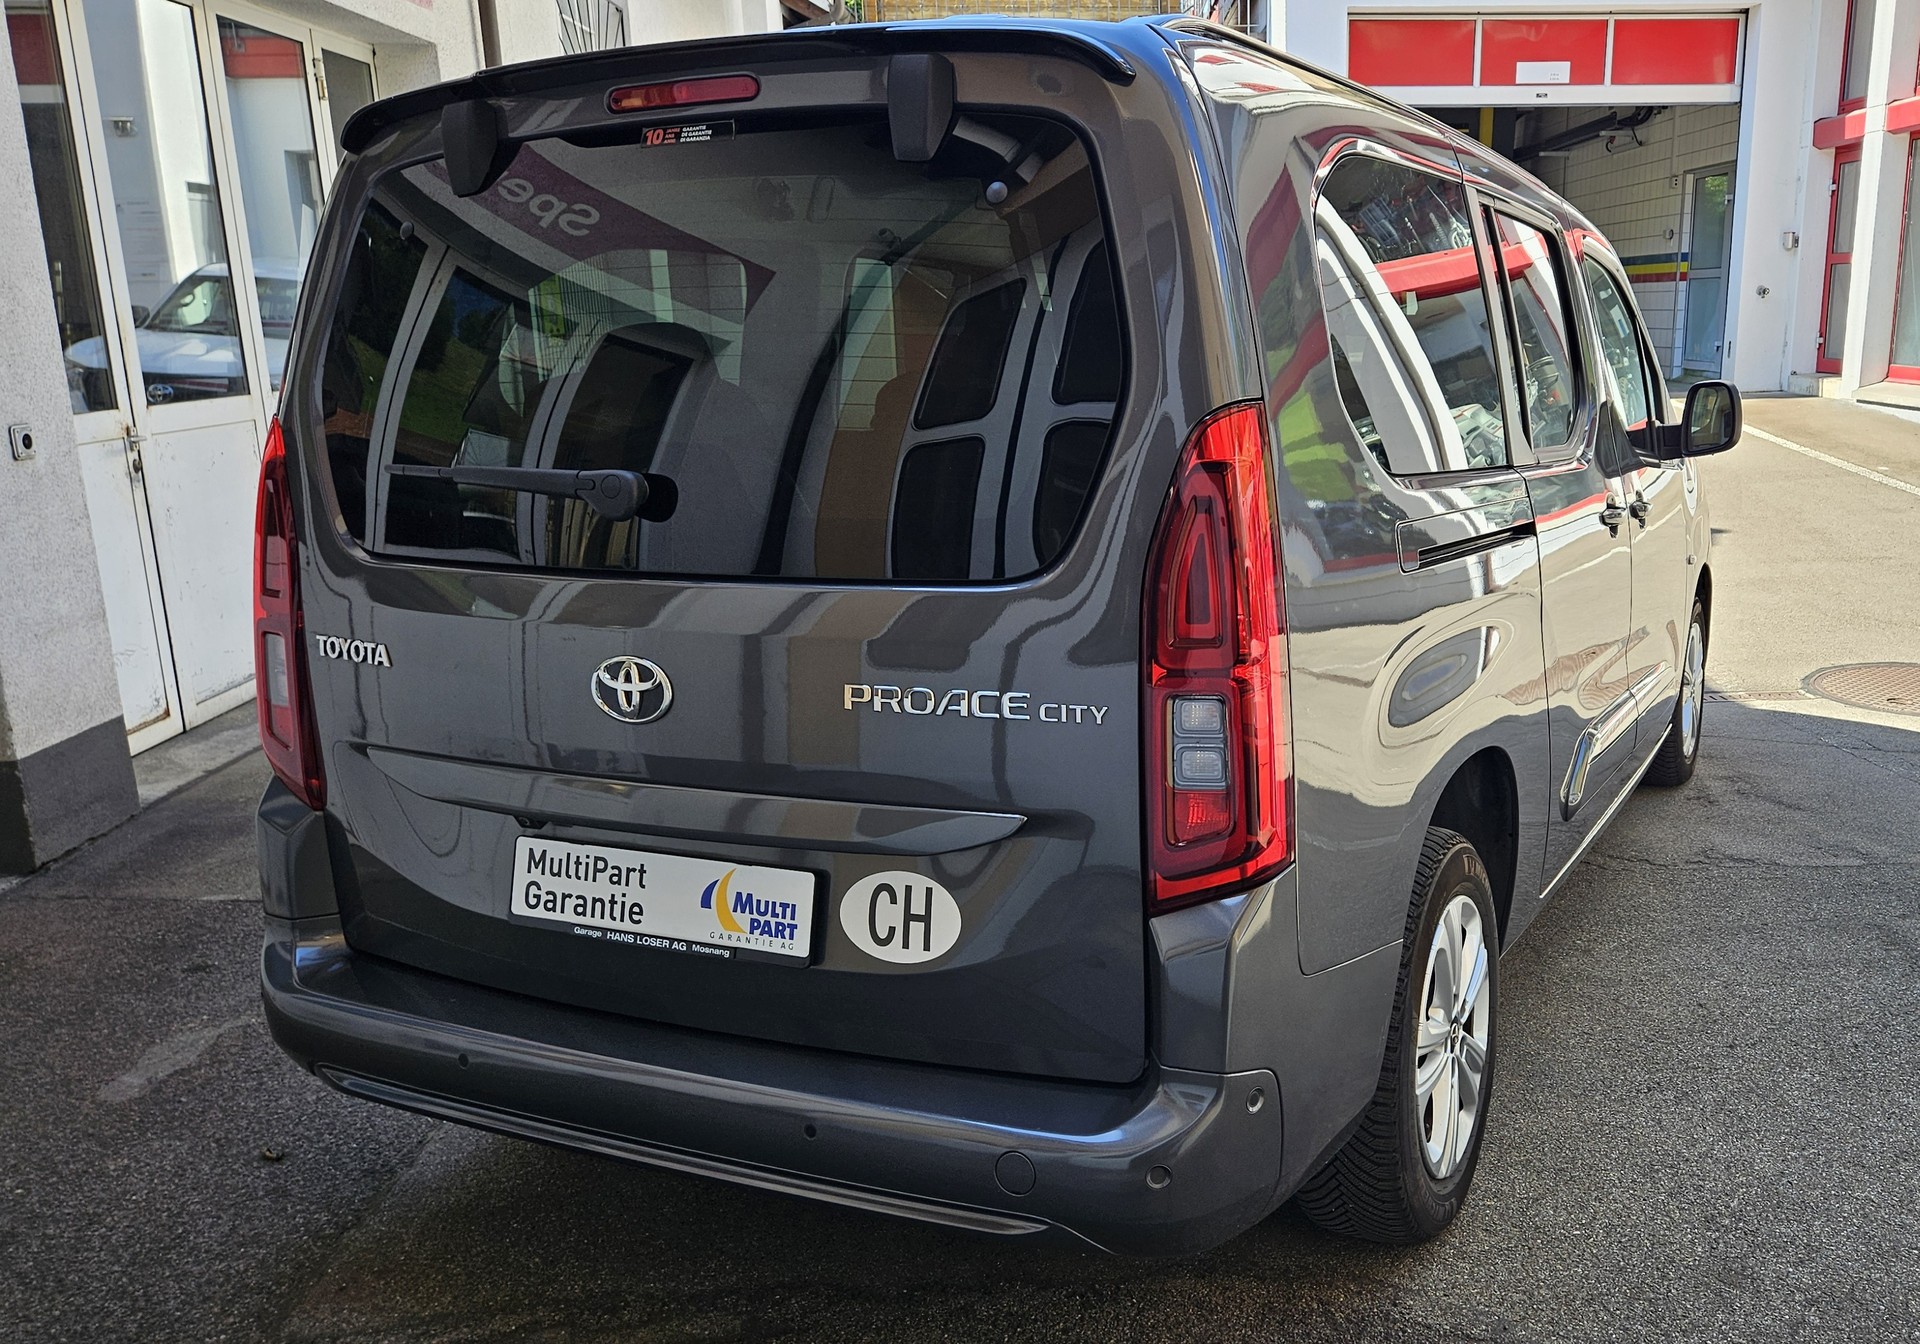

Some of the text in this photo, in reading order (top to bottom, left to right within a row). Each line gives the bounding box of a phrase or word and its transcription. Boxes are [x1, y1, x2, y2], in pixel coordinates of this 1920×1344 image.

[645, 128, 664, 146] 10
[688, 129, 713, 137] GARANTIE
[316, 634, 391, 667] TOYOTA
[844, 684, 1108, 725] PROACE CITY
[527, 847, 647, 889] MultiPart
[524, 880, 644, 925] Garantie
[732, 891, 797, 921] MULTI
[868, 882, 933, 952] CH
[574, 926, 730, 958] Garage HANS LOSER AG Mosnang
[709, 931, 795, 951] GARANTIE AG
[749, 917, 798, 941] PART
